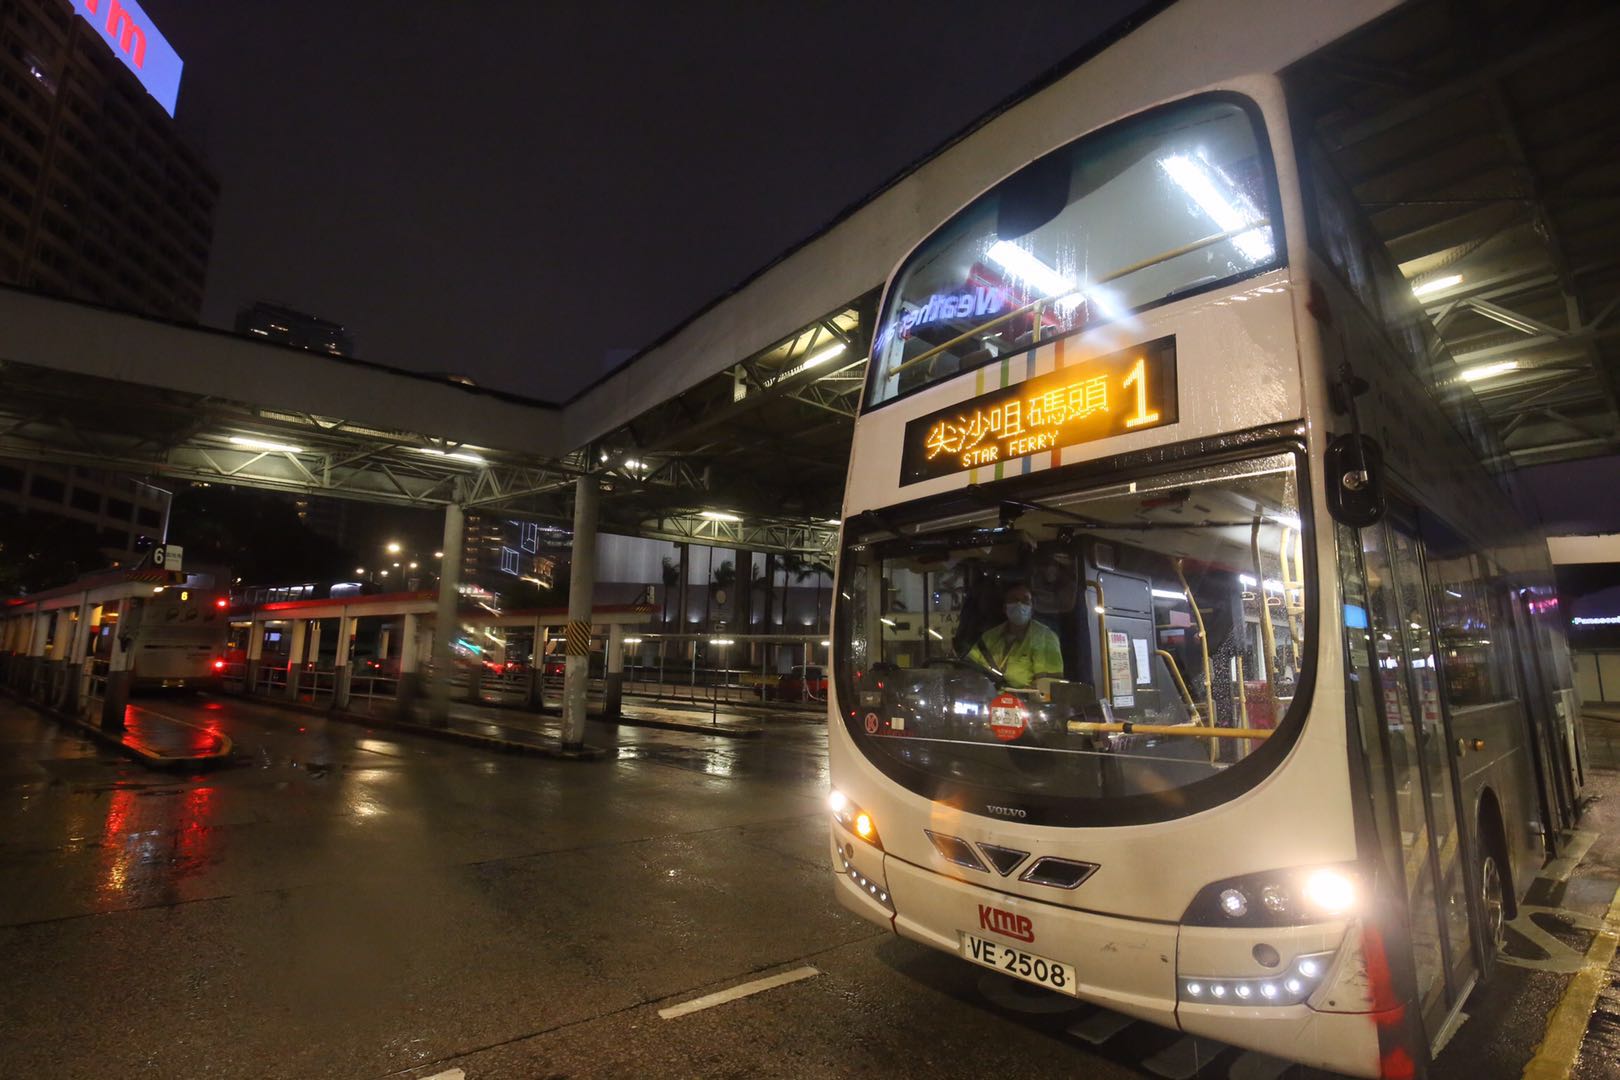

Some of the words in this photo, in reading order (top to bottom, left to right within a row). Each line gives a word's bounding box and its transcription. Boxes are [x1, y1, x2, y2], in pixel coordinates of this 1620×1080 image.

[1123, 358, 1159, 428] 1
[927, 374, 1109, 460] 尖沙咀碼頭
[962, 447, 999, 468] STAR
[1008, 430, 1060, 457] FERRY
[154, 548, 164, 564] 6
[986, 805, 1027, 818] VOLVO
[978, 904, 1036, 943] KMB
[970, 936, 996, 965] VE
[1004, 949, 1066, 988] 2508
